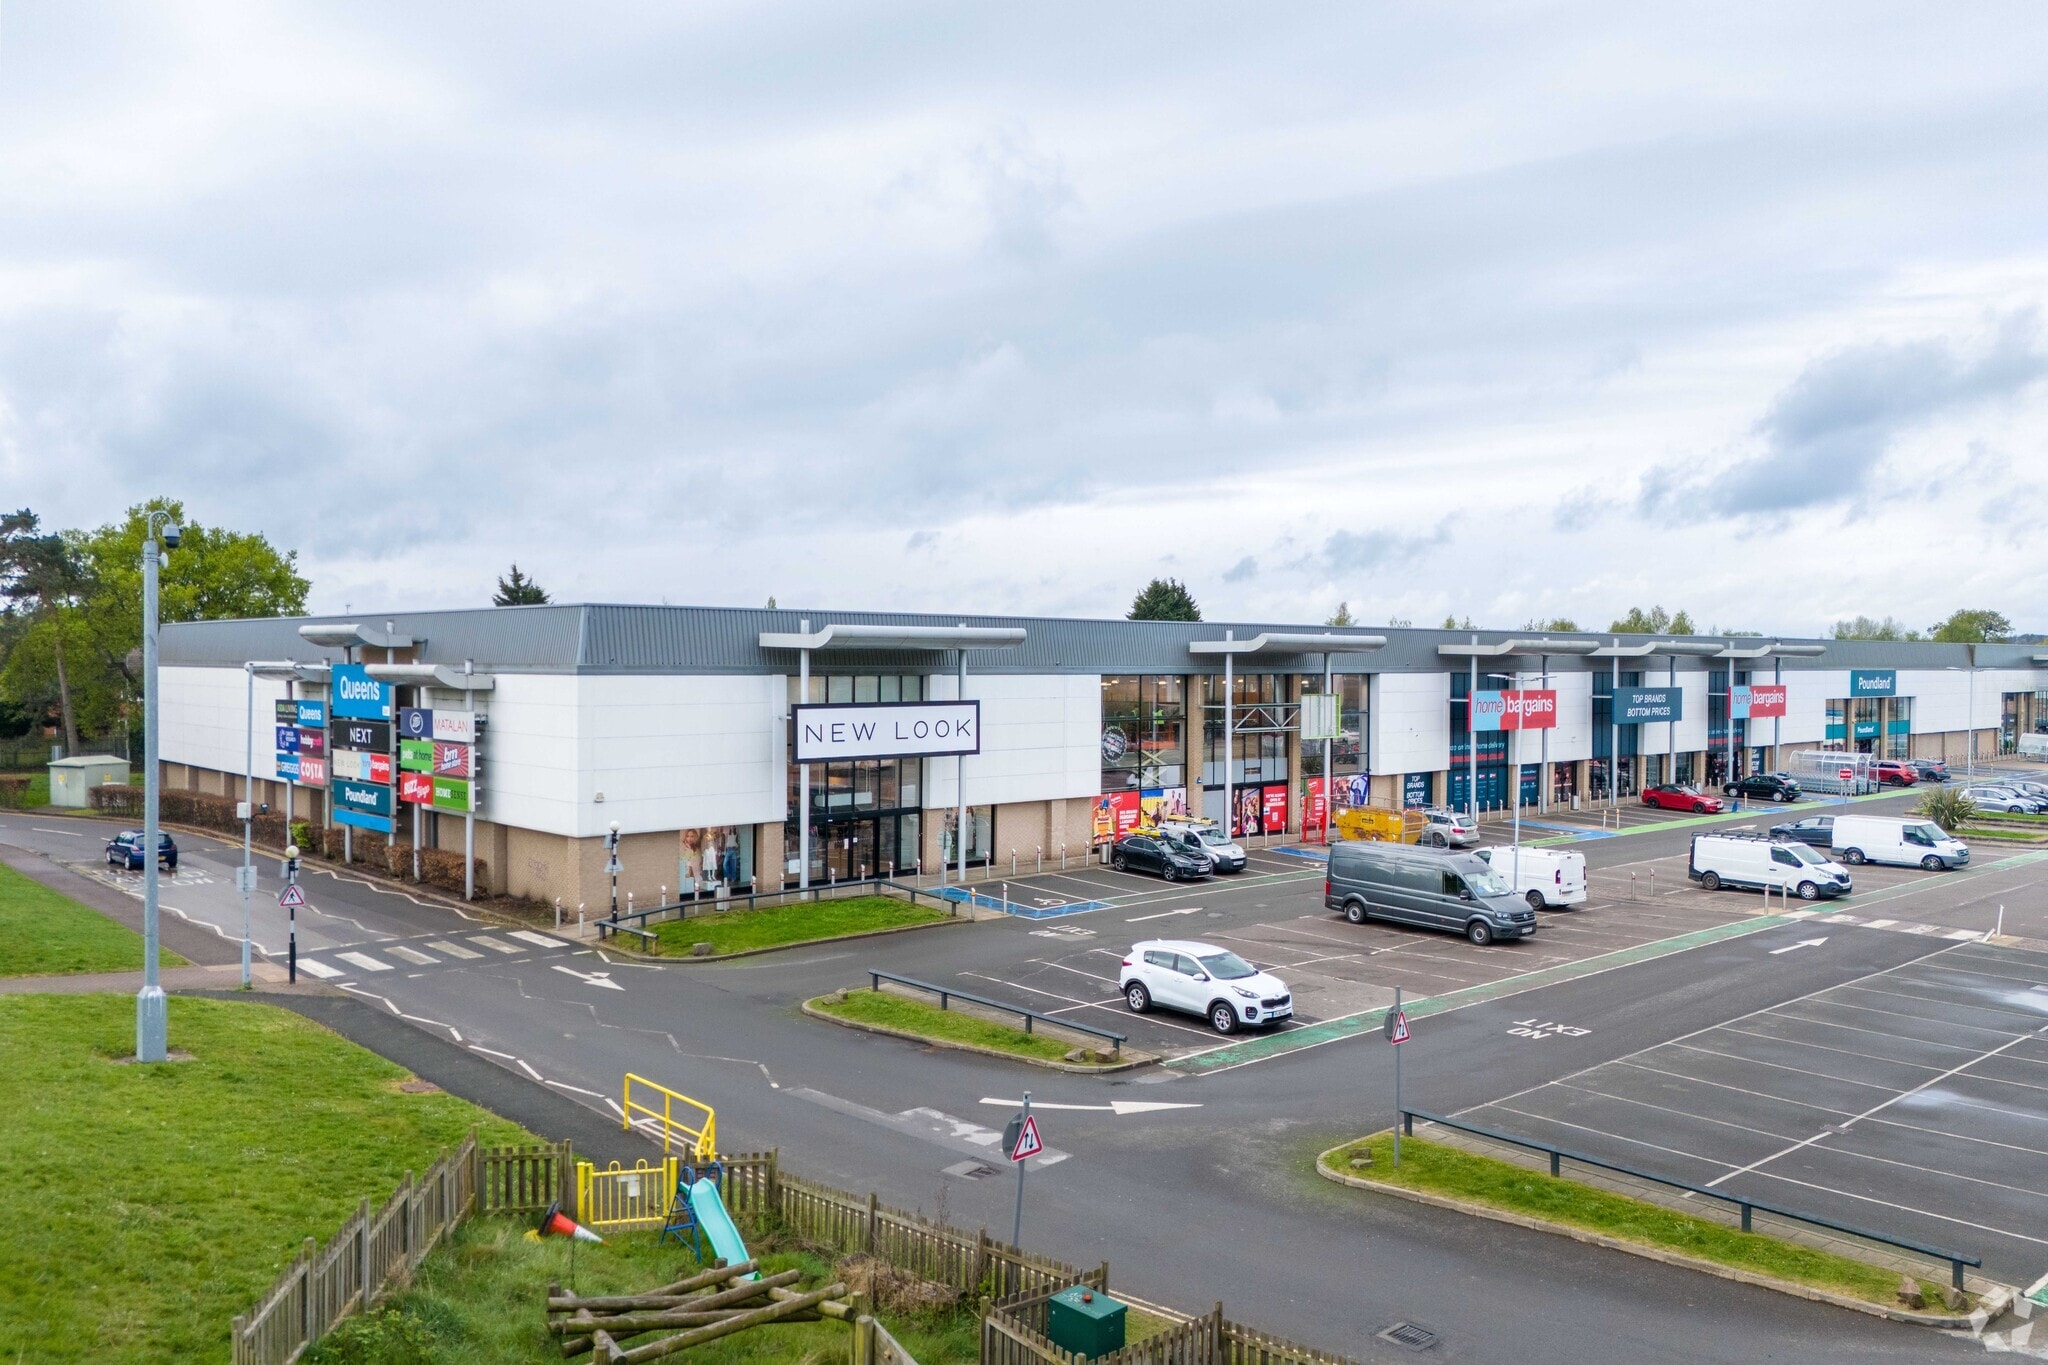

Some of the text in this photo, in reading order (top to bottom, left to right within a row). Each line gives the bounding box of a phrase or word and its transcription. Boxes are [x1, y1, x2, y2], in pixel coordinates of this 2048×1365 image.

[340, 675, 380, 701] Queens
[1858, 677, 1891, 690] Poundland
[1475, 695, 1553, 717] home bargains
[1632, 694, 1666, 704] TOP BRANDS
[1733, 690, 1784, 707] home bargains
[300, 706, 322, 721] Queens
[1627, 706, 1671, 717] BOTTOM PRICES
[434, 719, 467, 733] MATALAN
[805, 718, 972, 744] NEW LOOK
[350, 727, 373, 744] NEXT
[282, 762, 298, 774] GREGGS
[301, 762, 324, 780] COSTA
[345, 786, 377, 806] Poundland
[1506, 1028, 1552, 1039] NO
[1512, 1018, 1592, 1036] EXIT
